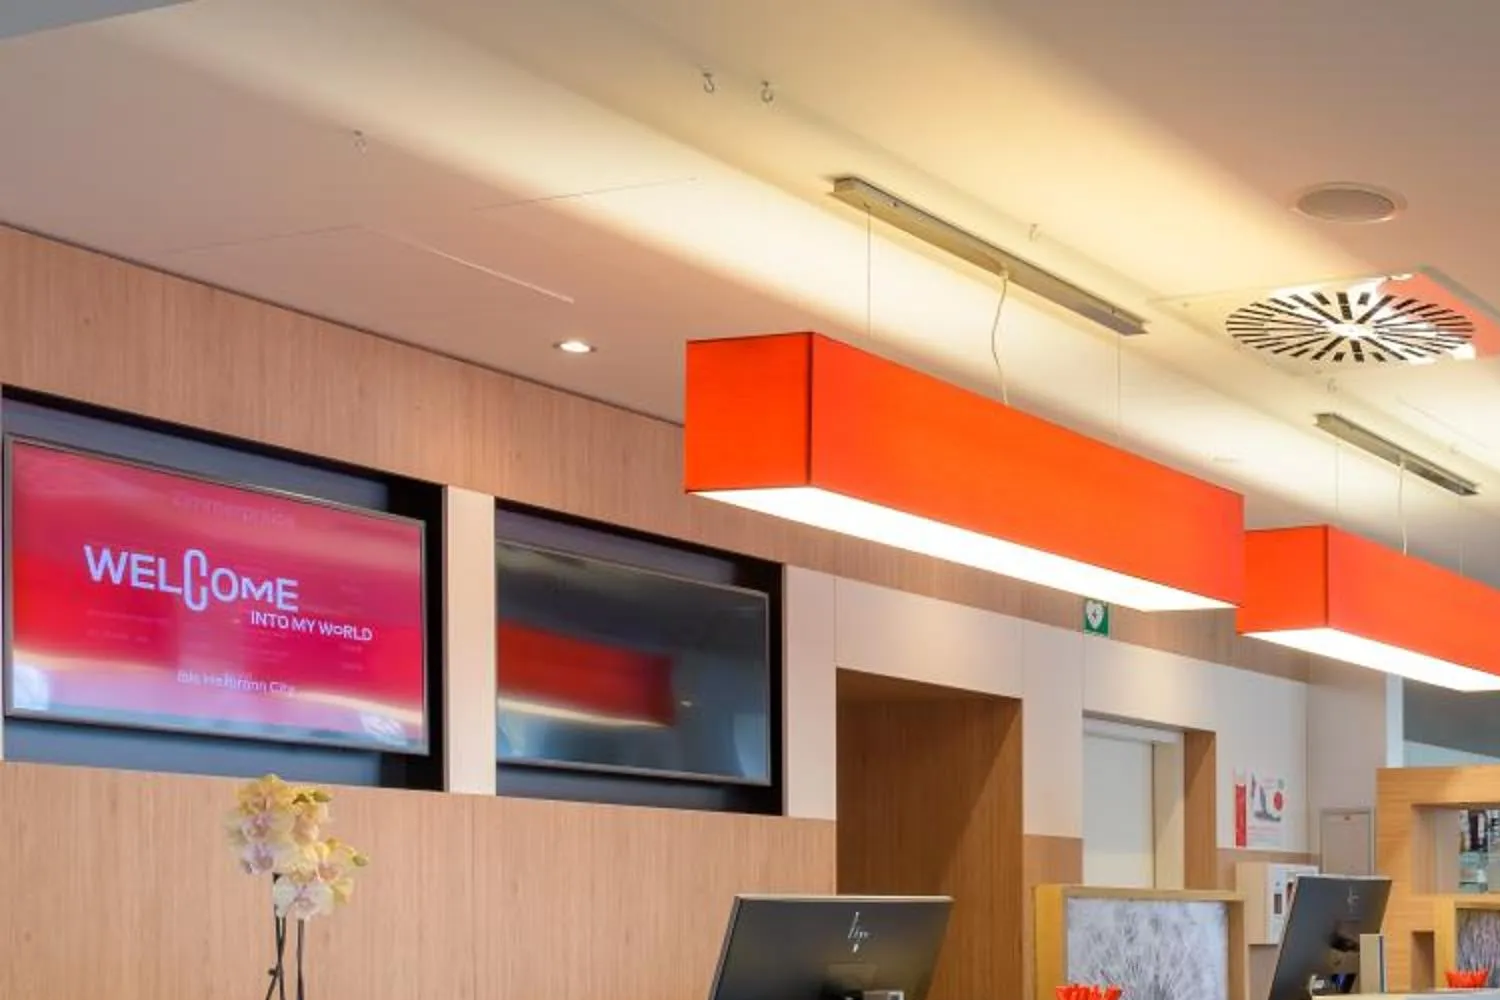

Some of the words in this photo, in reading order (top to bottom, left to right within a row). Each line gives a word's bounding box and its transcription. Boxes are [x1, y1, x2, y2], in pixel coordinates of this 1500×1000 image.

[84, 544, 299, 612] WELCOME
[251, 610, 289, 629] INTO
[291, 616, 316, 634] MY
